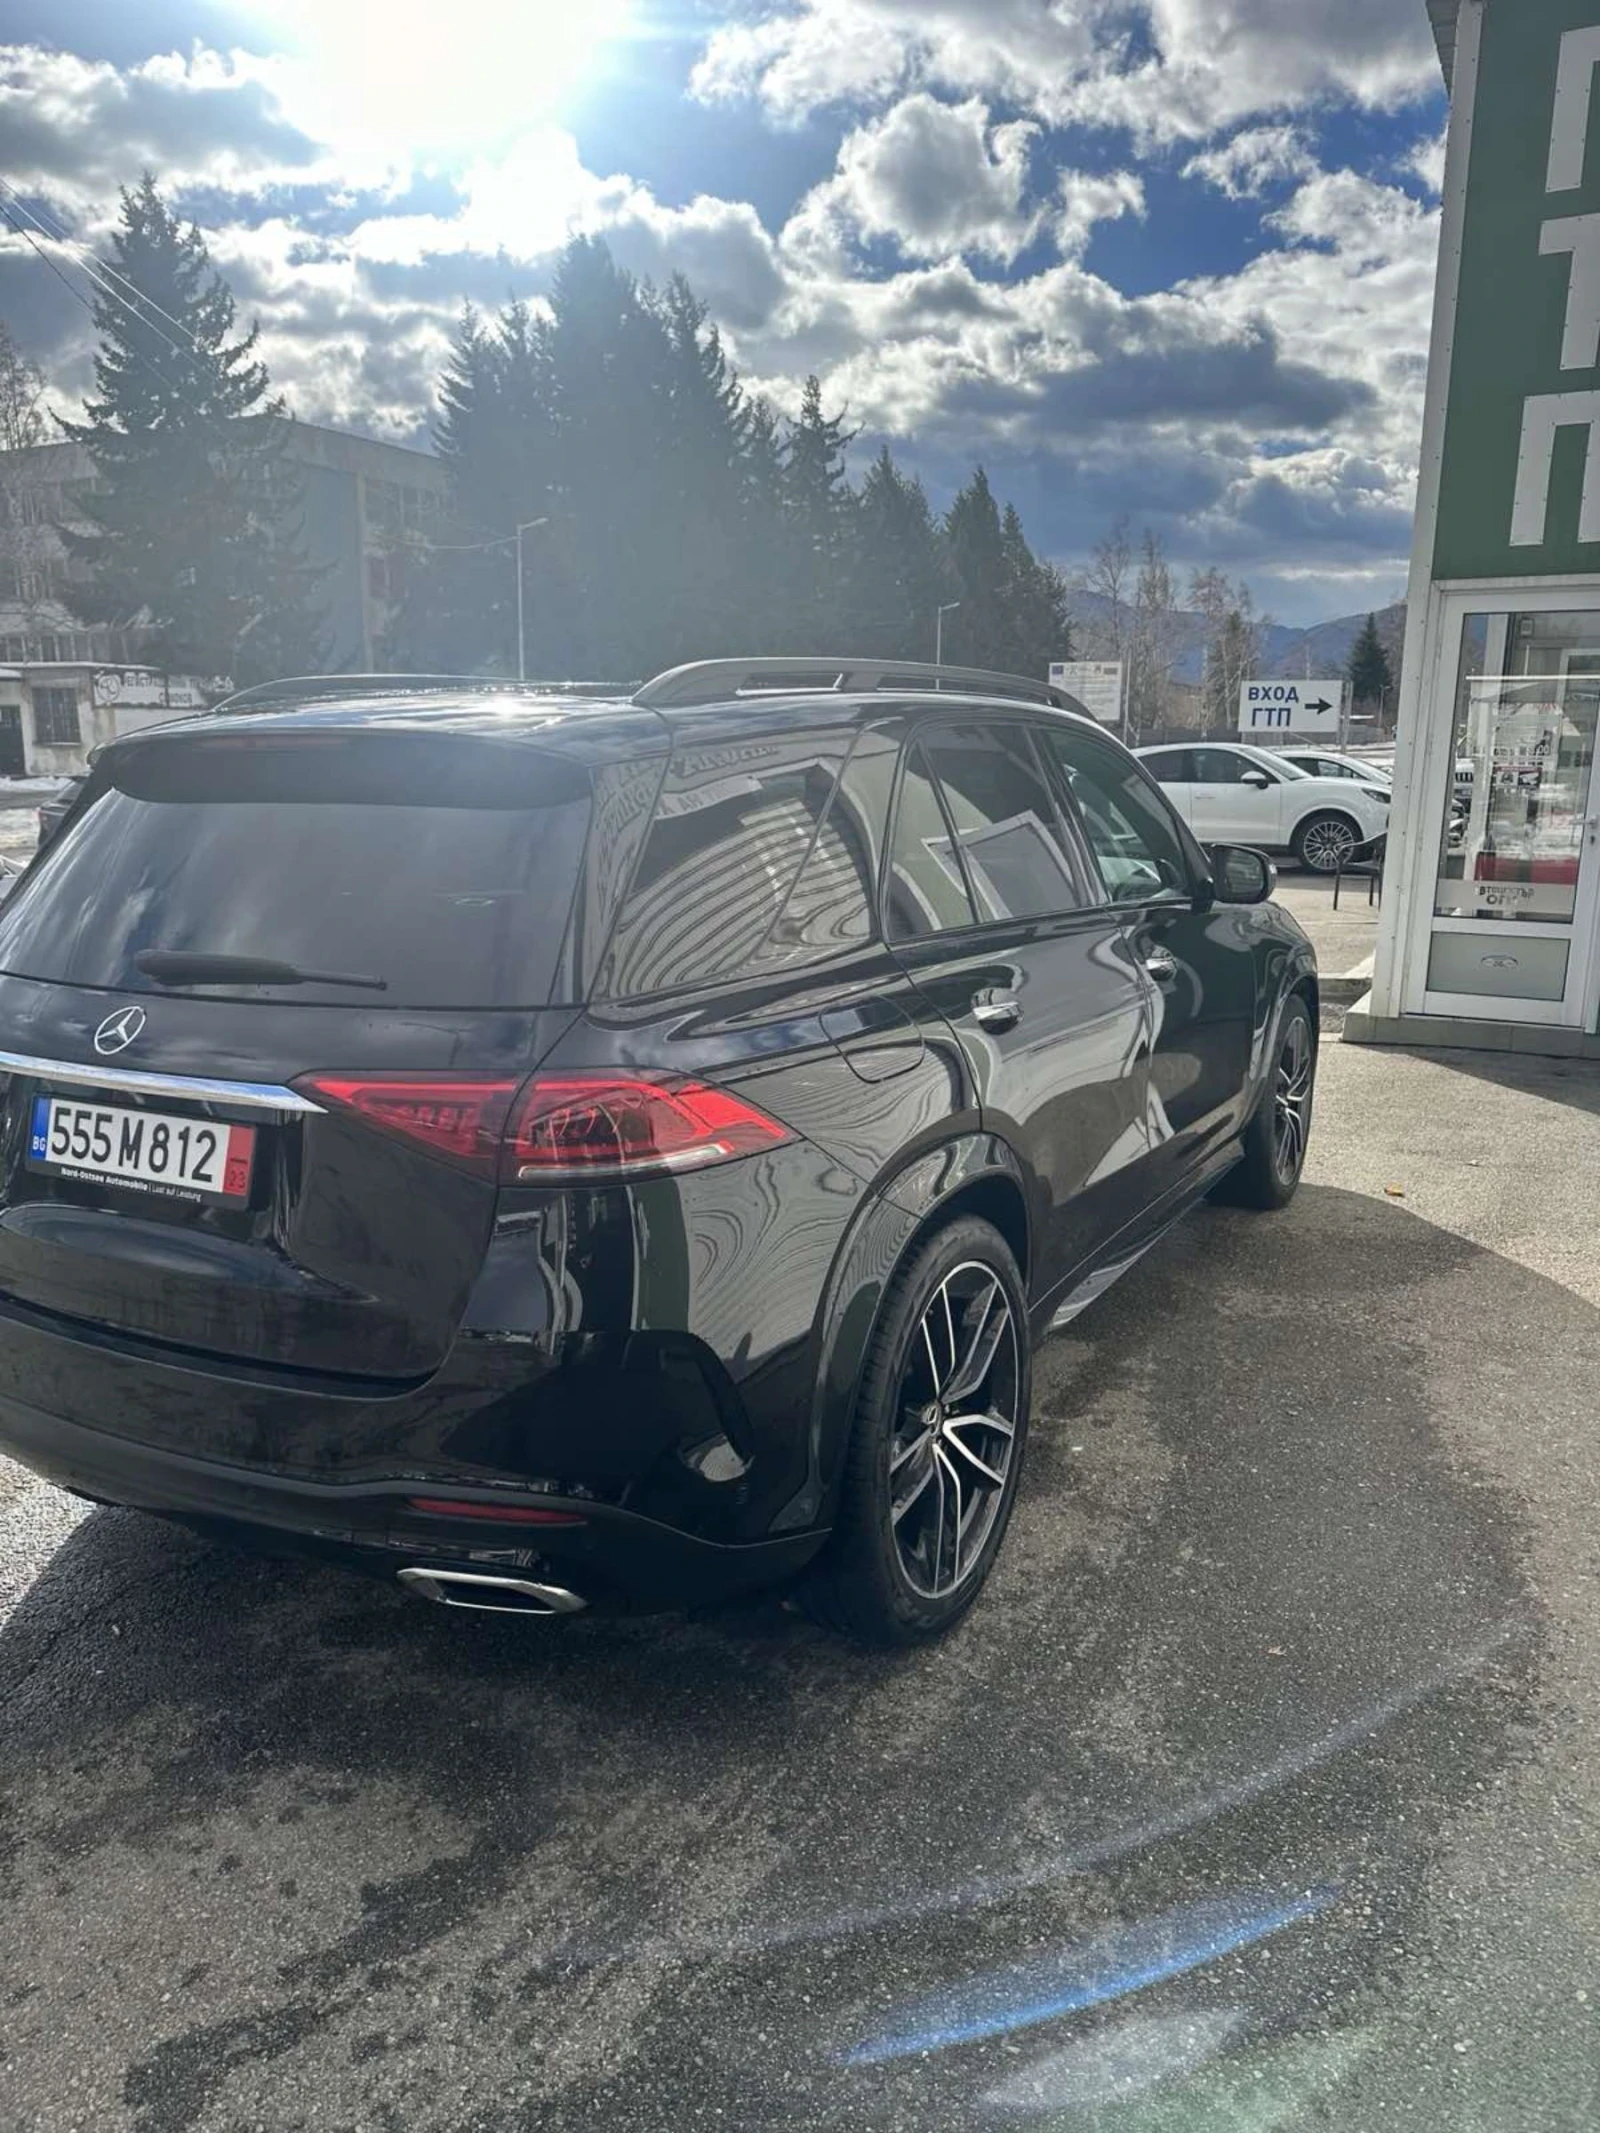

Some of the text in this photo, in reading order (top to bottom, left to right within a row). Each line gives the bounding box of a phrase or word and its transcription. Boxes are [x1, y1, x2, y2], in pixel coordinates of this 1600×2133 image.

[1248, 686, 1299, 703] ВХОД
[1251, 707, 1291, 727] ГТП
[32, 1135, 46, 1151] BG
[51, 1106, 217, 1183] 555M812
[105, 1175, 148, 1191] Automobile
